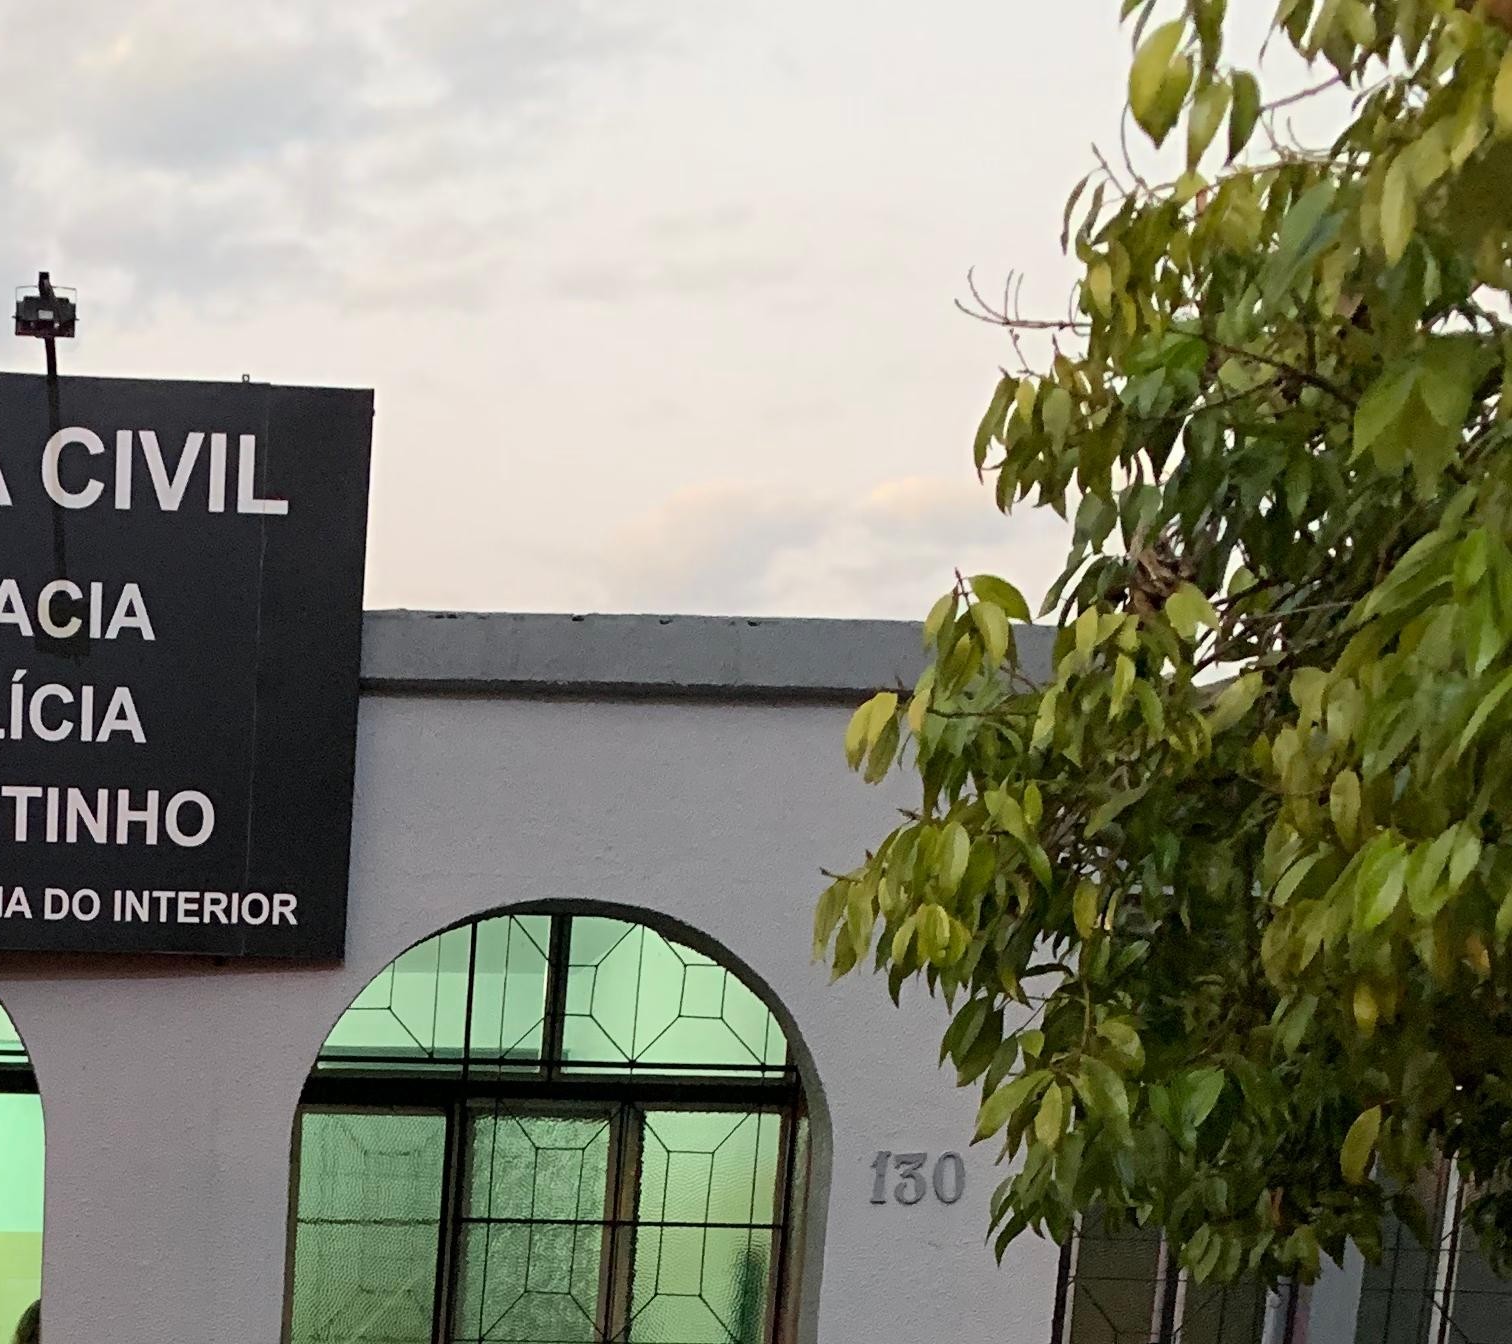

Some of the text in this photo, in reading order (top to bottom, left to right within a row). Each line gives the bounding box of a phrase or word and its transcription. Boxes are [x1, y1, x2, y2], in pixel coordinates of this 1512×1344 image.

[41, 426, 289, 515] CIVIL
[43, 887, 101, 921] DO
[114, 889, 298, 926] INTERIOR
[870, 1150, 966, 1205] 130
